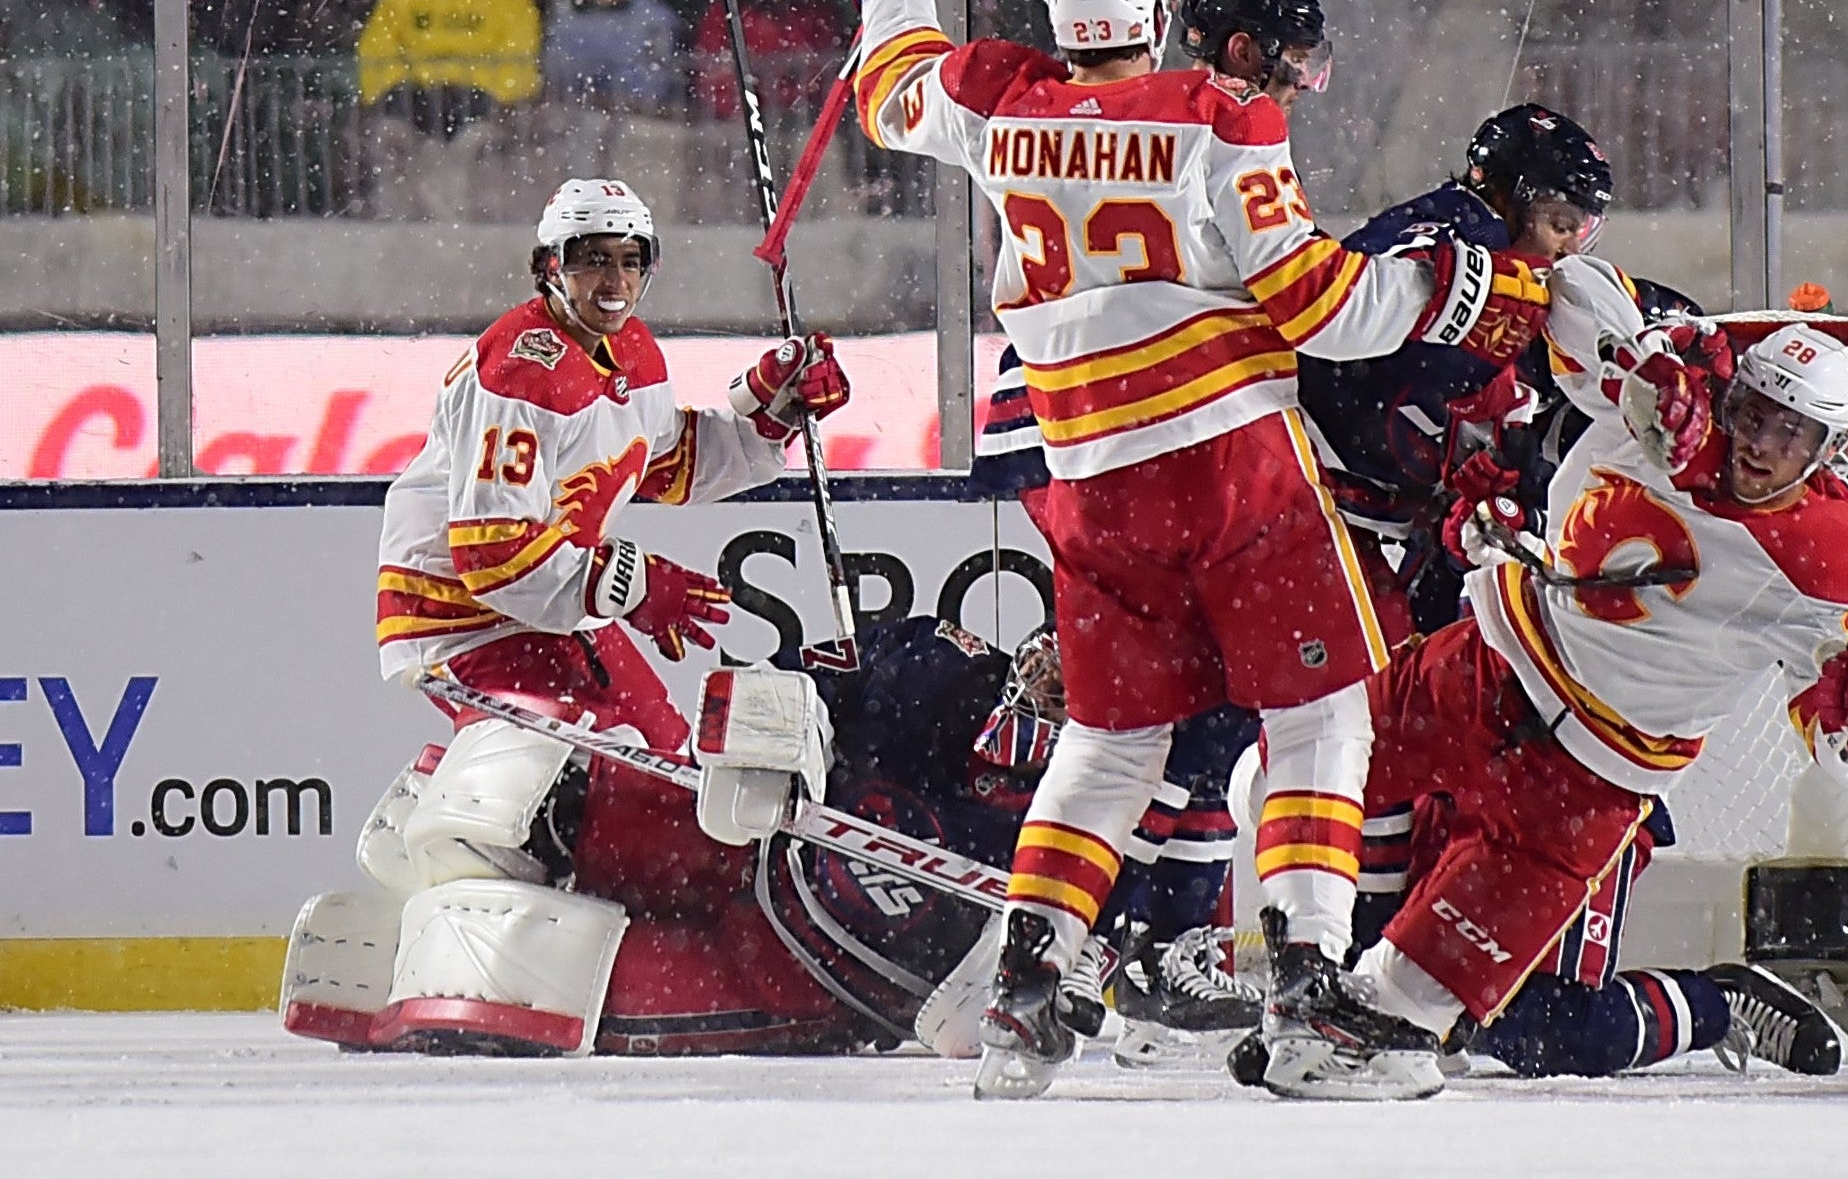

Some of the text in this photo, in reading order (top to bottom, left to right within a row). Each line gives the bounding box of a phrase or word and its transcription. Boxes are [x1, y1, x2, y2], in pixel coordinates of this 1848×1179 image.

[1073, 20, 1112, 43] 23
[989, 125, 1176, 184] MONAHAN
[601, 184, 626, 197] 13
[1782, 339, 1818, 365] 28
[476, 424, 539, 488] 13
[1431, 896, 1513, 964] CCM
